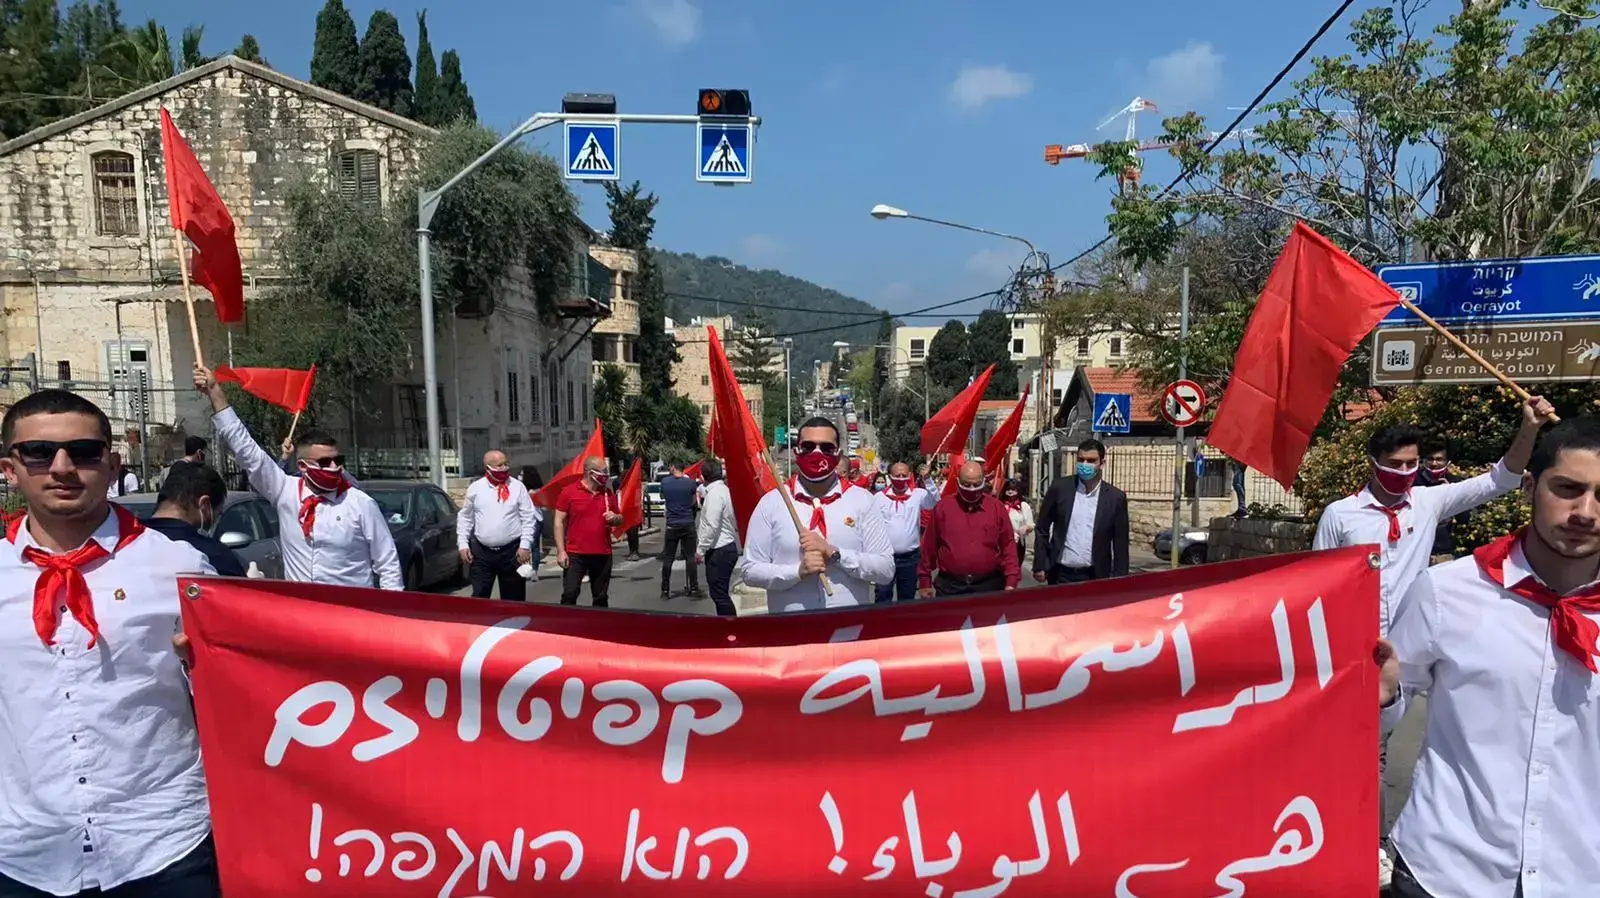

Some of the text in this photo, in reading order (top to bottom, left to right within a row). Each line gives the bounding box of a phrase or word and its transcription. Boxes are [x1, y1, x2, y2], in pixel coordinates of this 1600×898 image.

[1472, 266, 1515, 281] קריות
[1472, 283, 1512, 299] كريوت
[1461, 300, 1522, 313] Qerayot
[1497, 330, 1563, 344] המושבה
[1496, 362, 1555, 375] Colony
[800, 593, 1334, 742] الرأسمالية
[263, 615, 744, 784] קפיטליזם
[620, 808, 750, 882] הוא
